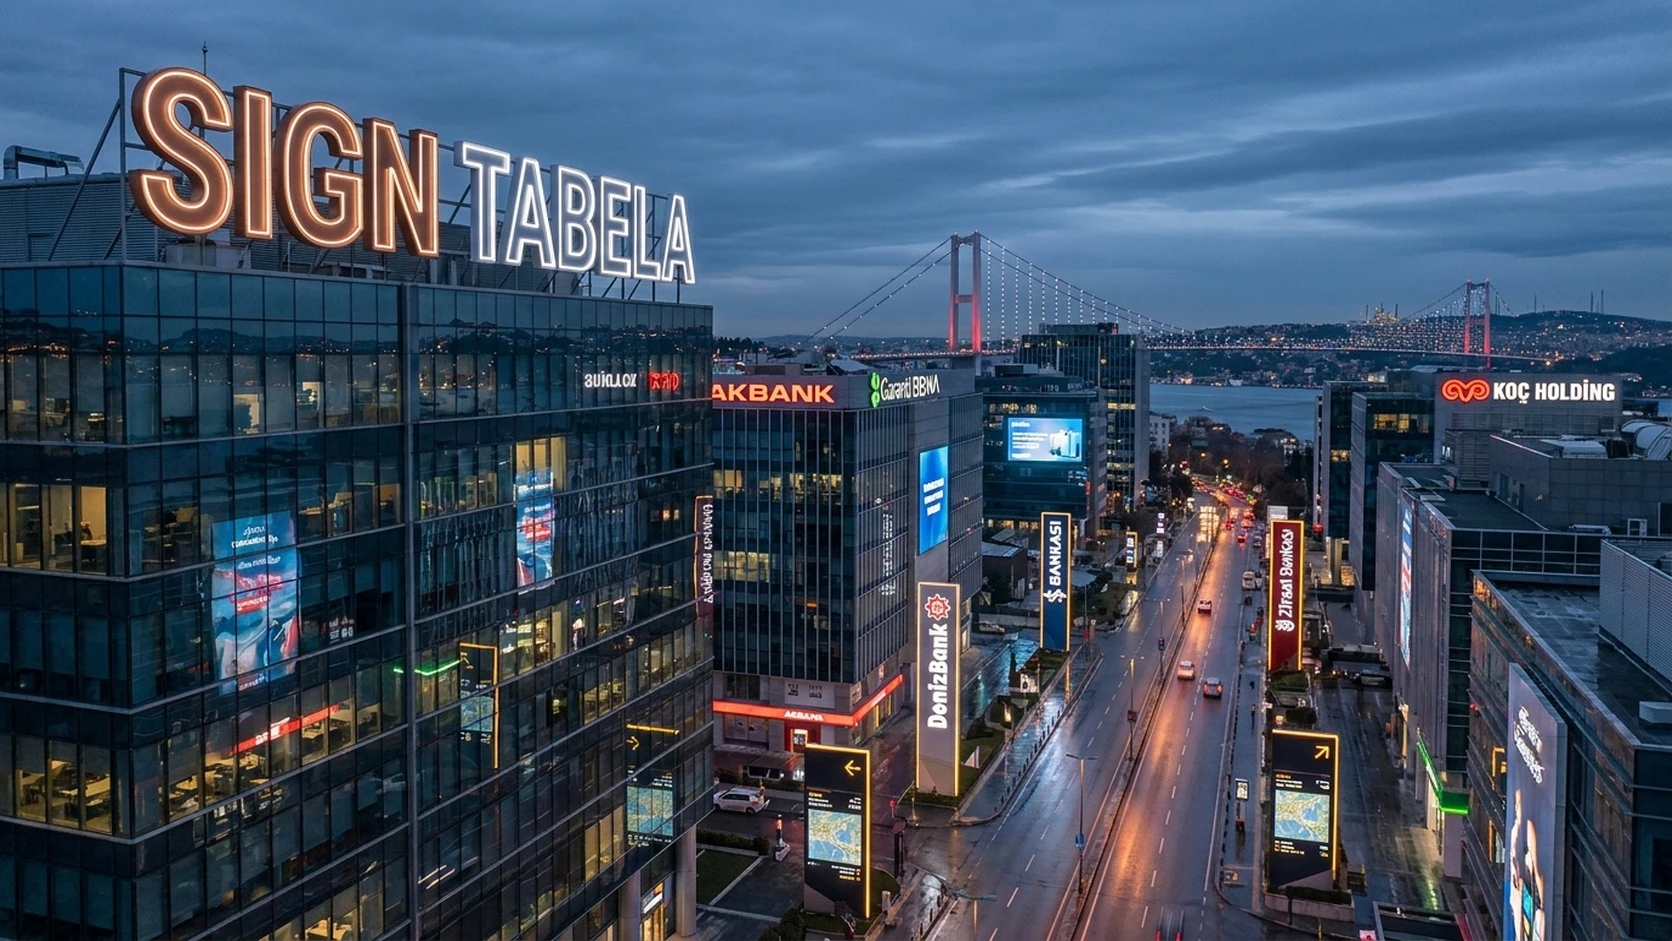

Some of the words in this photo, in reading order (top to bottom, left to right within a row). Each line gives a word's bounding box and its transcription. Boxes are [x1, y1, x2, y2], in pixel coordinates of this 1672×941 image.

[129, 67, 439, 258] SIGN
[454, 141, 695, 284] TABELA
[712, 384, 835, 403] AKBANK
[1493, 382, 1530, 404] KOÇ
[1535, 379, 1616, 401] HOLDİNG
